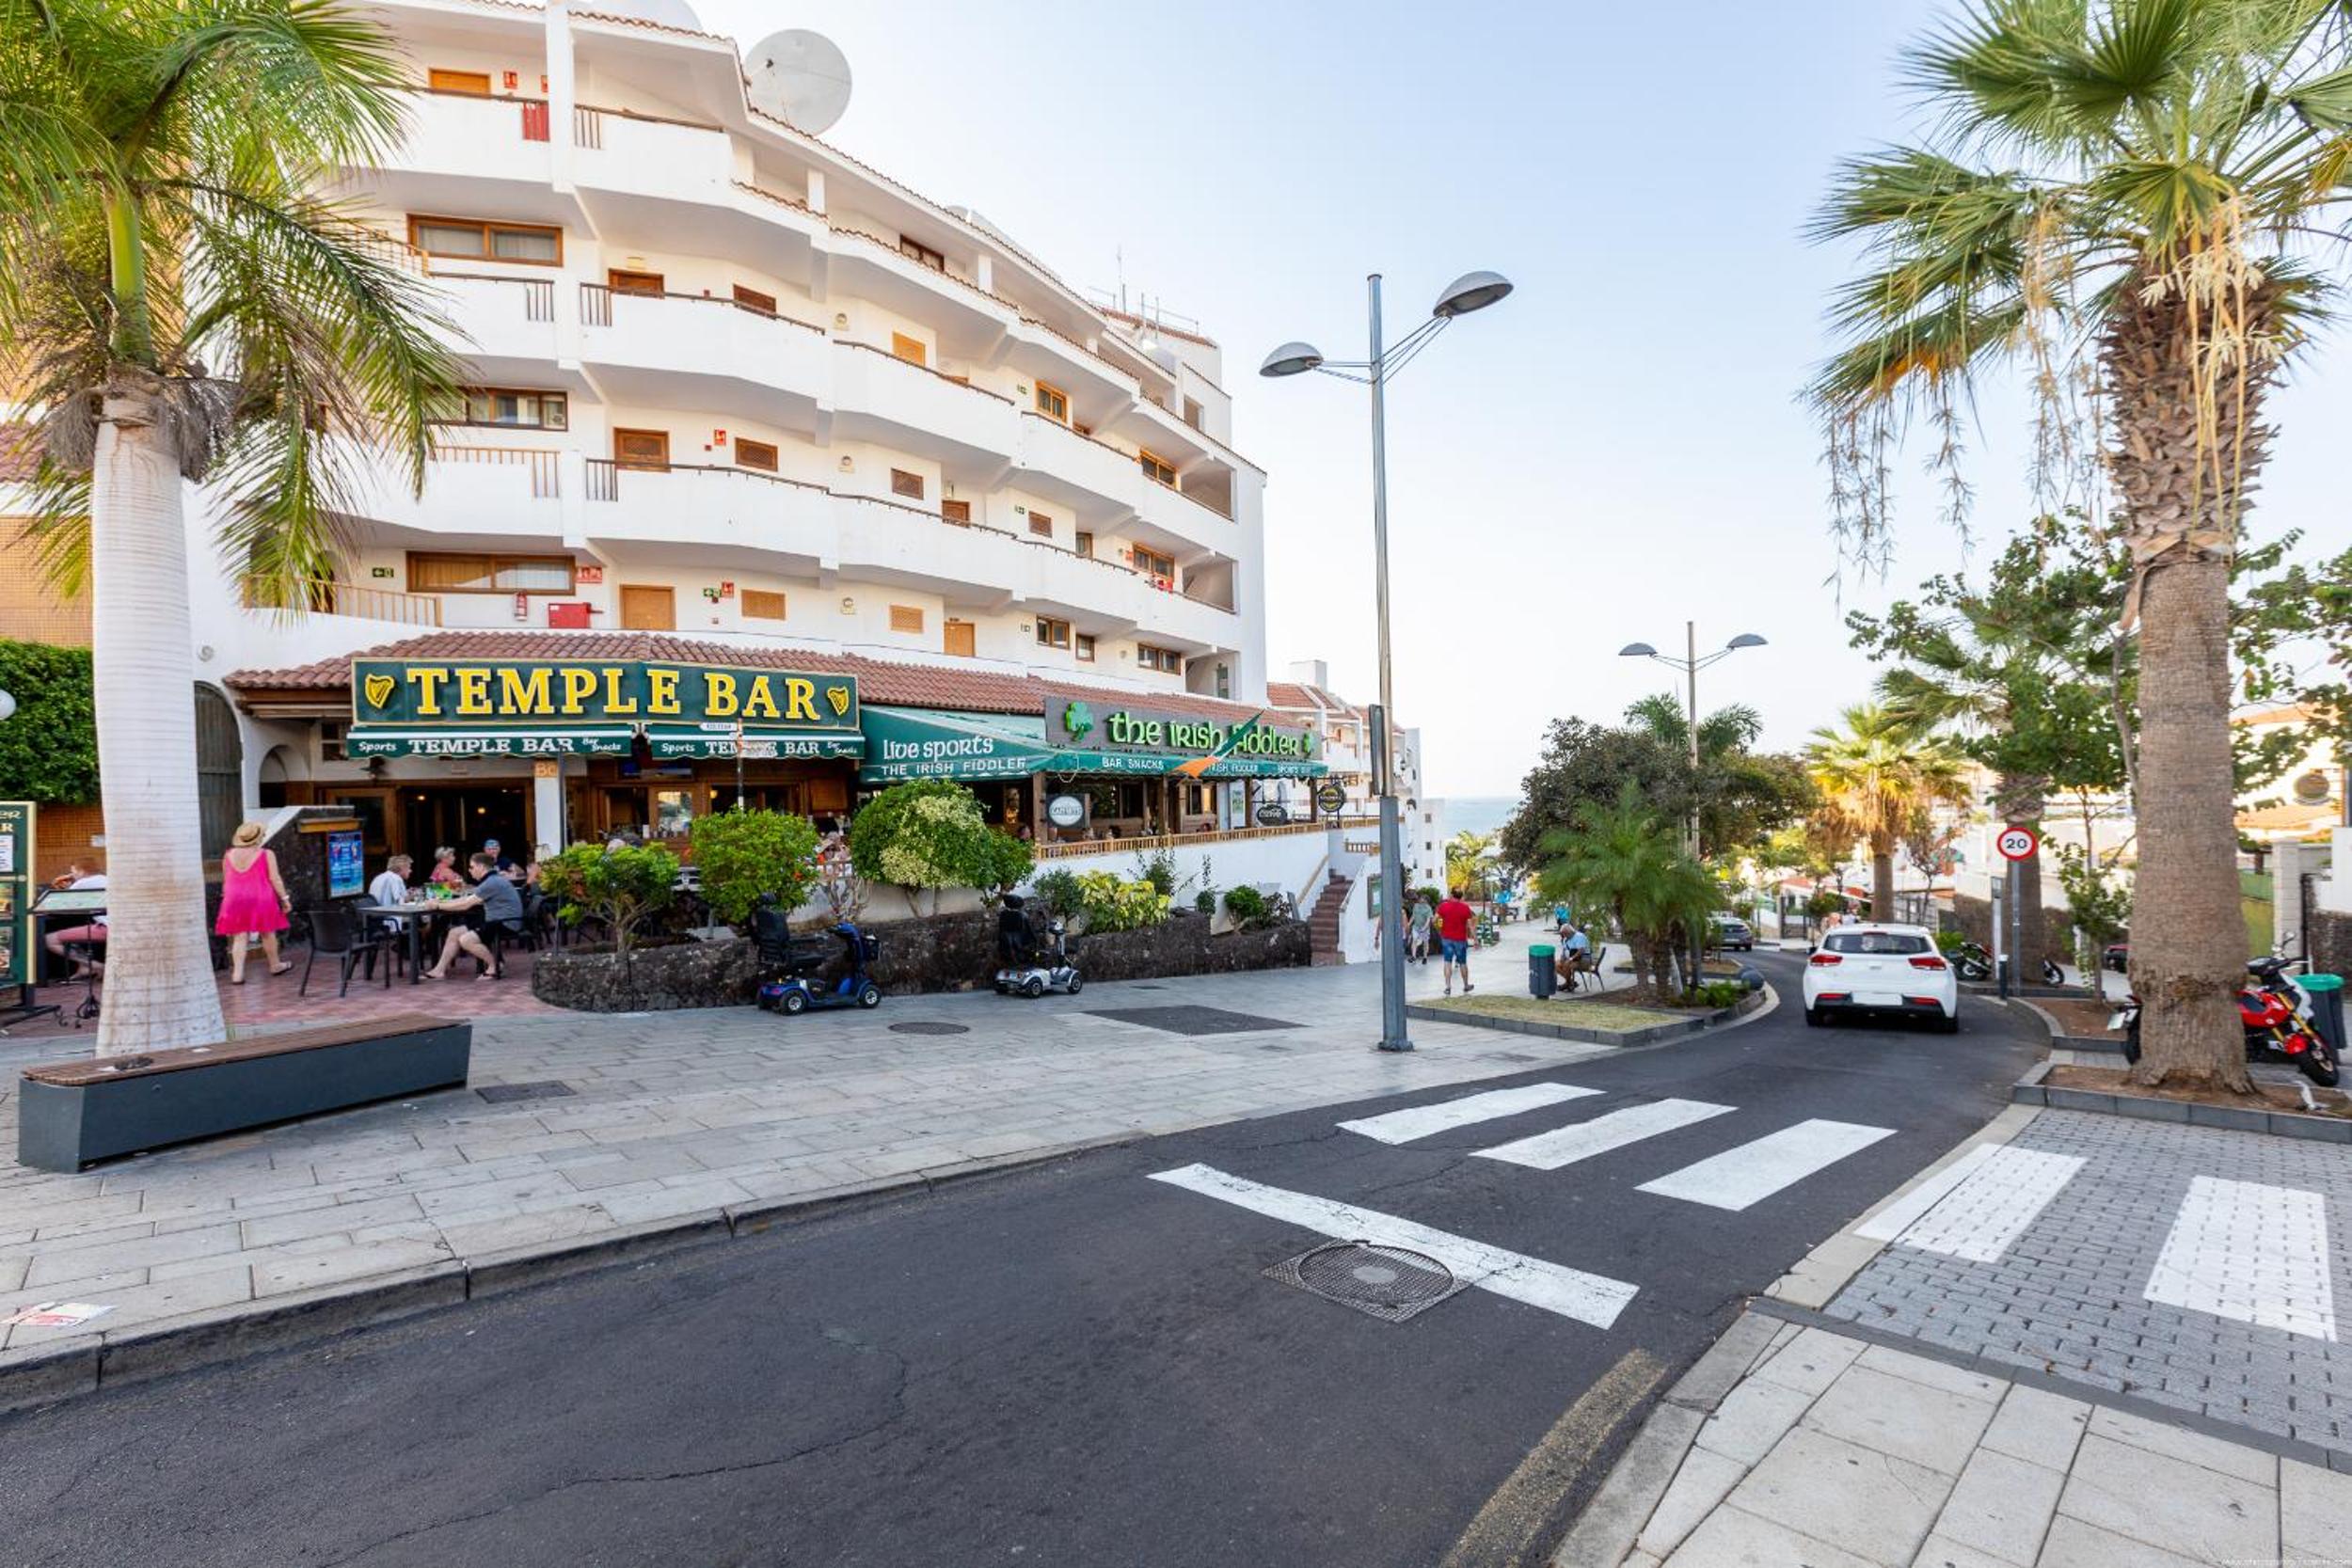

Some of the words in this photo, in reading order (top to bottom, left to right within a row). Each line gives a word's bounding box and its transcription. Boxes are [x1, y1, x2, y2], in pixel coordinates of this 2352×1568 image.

[406, 667, 681, 716] TEMPLE
[704, 672, 821, 721] BAR
[1107, 711, 1162, 746] the
[358, 741, 397, 752] Sports
[408, 739, 511, 753] TEMPLE
[521, 737, 575, 752] BAR
[660, 742, 696, 752] Sports
[785, 741, 820, 753] BAR
[923, 736, 993, 763] sports
[882, 764, 907, 776] THE
[916, 762, 954, 774] IRISH
[963, 758, 1026, 772] FIDDLER
[1102, 756, 1122, 768] BAR
[1128, 758, 1164, 770] SNACKS
[2006, 838, 2027, 849] 20
